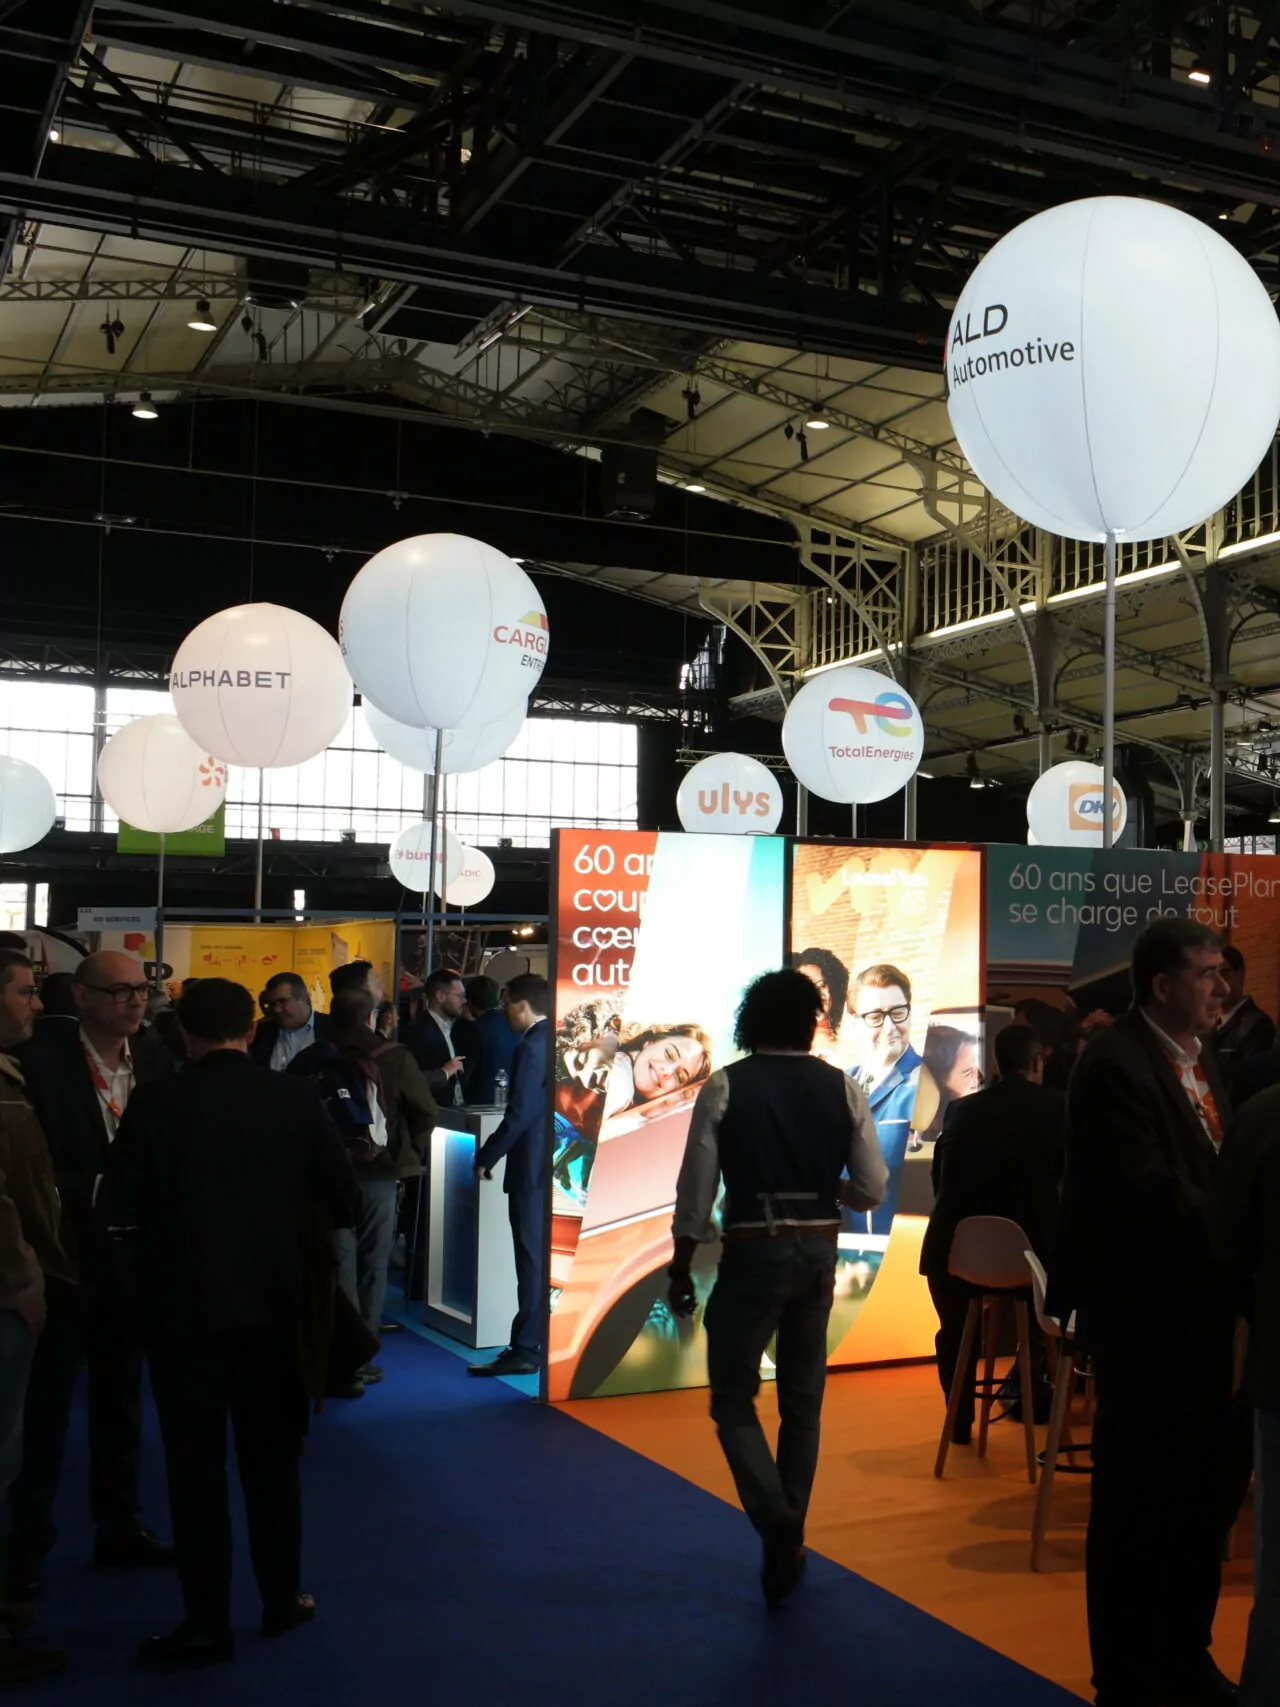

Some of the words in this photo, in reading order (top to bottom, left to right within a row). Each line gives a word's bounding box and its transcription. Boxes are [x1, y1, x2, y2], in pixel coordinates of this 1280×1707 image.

[951, 304, 1008, 354] ALD
[953, 337, 1074, 389] Automotive
[172, 670, 291, 689] ALPHABET
[829, 745, 914, 762] TotalEnergies
[698, 783, 771, 817] ulys
[573, 844, 615, 875] 60
[1009, 864, 1041, 890] 60
[1050, 871, 1096, 893] ans
[1103, 873, 1152, 900] que
[1009, 903, 1038, 923] se
[1046, 897, 1138, 932] charge
